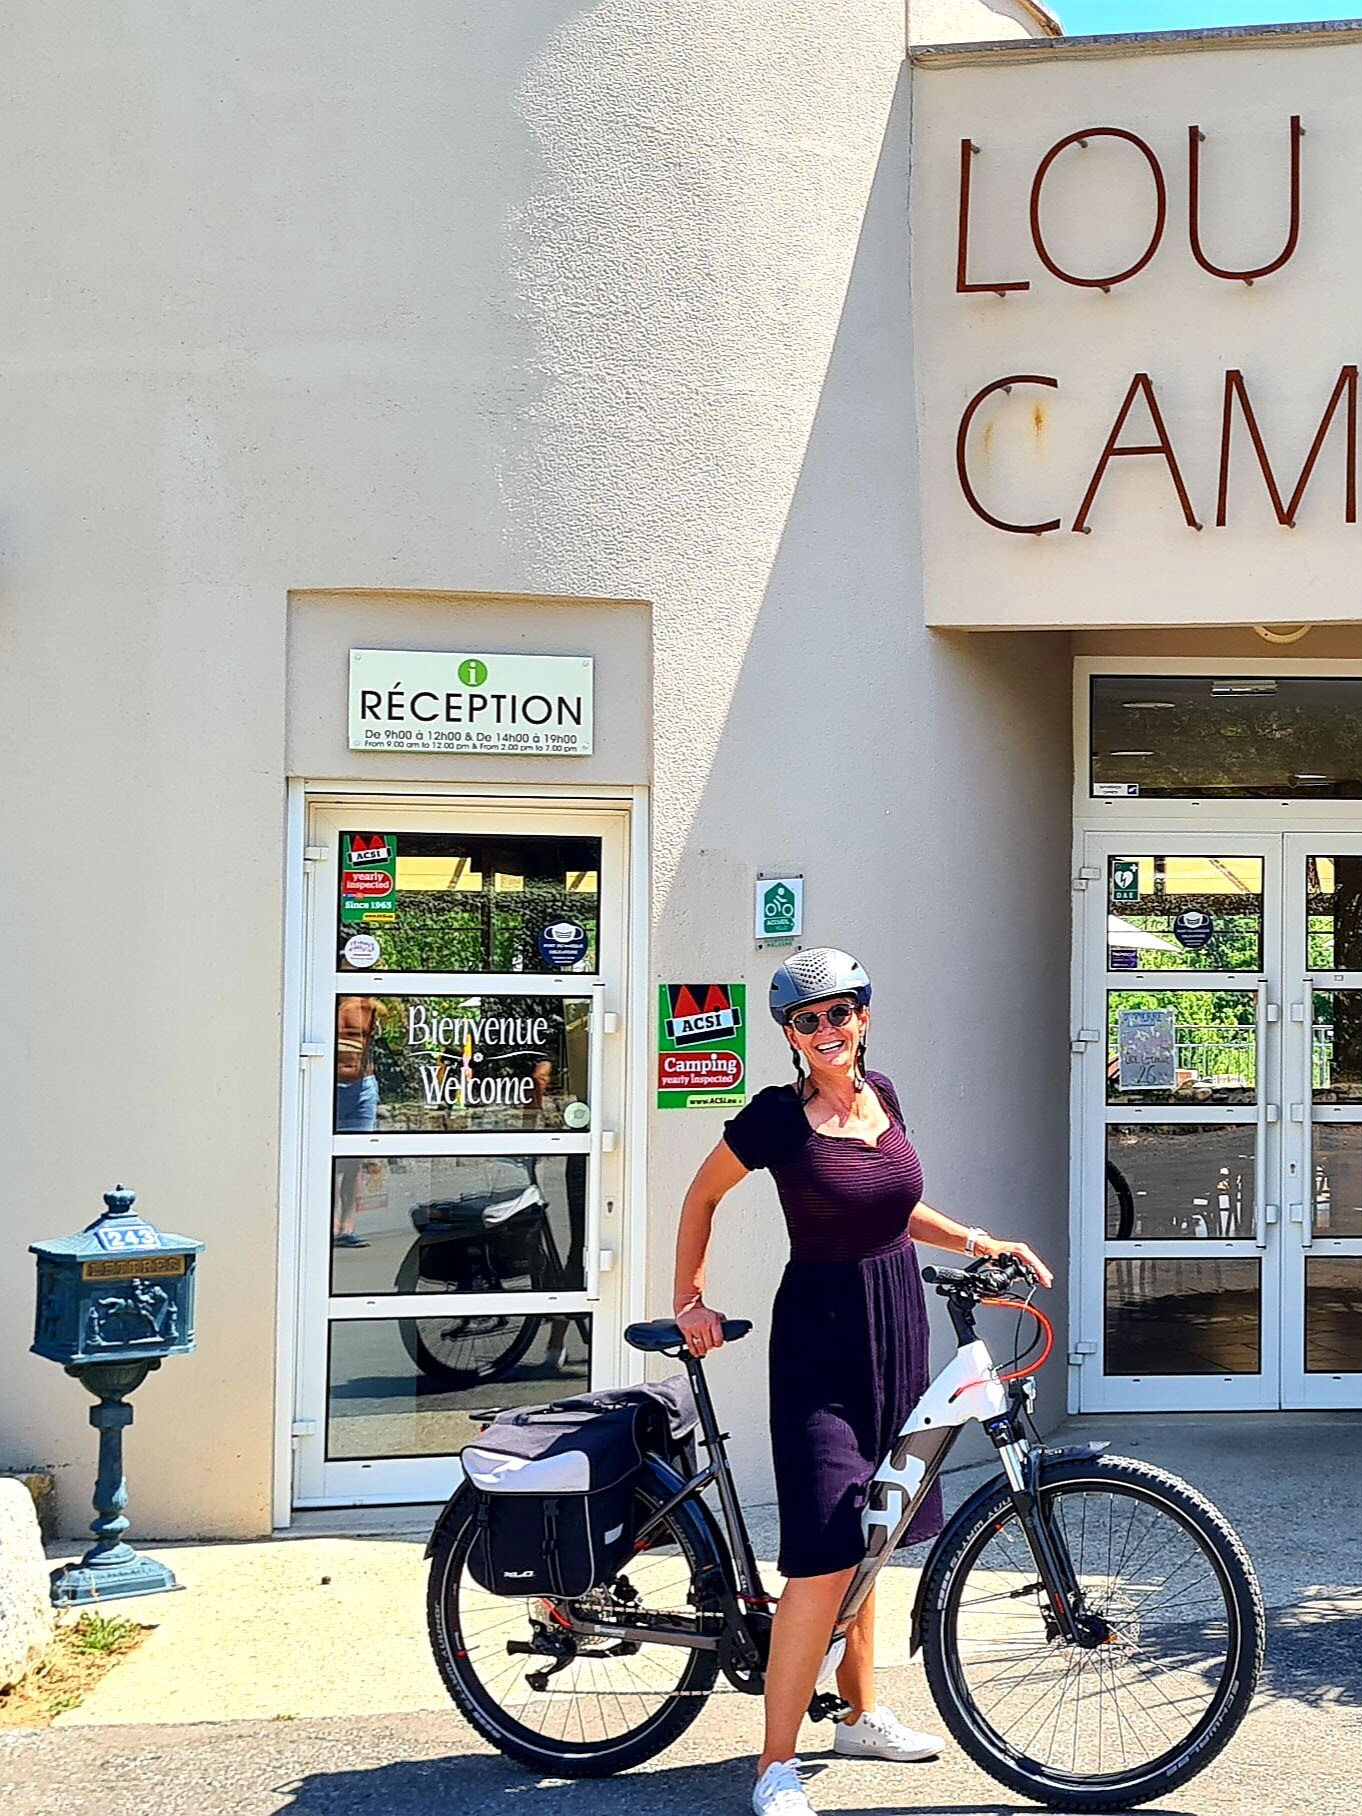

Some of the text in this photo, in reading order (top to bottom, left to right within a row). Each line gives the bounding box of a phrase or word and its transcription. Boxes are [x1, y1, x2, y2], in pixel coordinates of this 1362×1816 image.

[956, 115, 1301, 294] LOU
[361, 682, 582, 725] RÉCEPTION
[365, 730, 577, 744] De 9h00 à 12h00 & De 14h00 à 19h00
[535, 744, 543, 752] to
[353, 872, 384, 882] yearly
[345, 901, 369, 909] Since
[407, 1005, 548, 1046] Bienvenue
[664, 1053, 738, 1074] Camping
[420, 1063, 535, 1106] Welcome
[661, 1075, 690, 1086] yearly
[107, 1230, 155, 1247] 243
[87, 1258, 179, 1277] LETTRES
